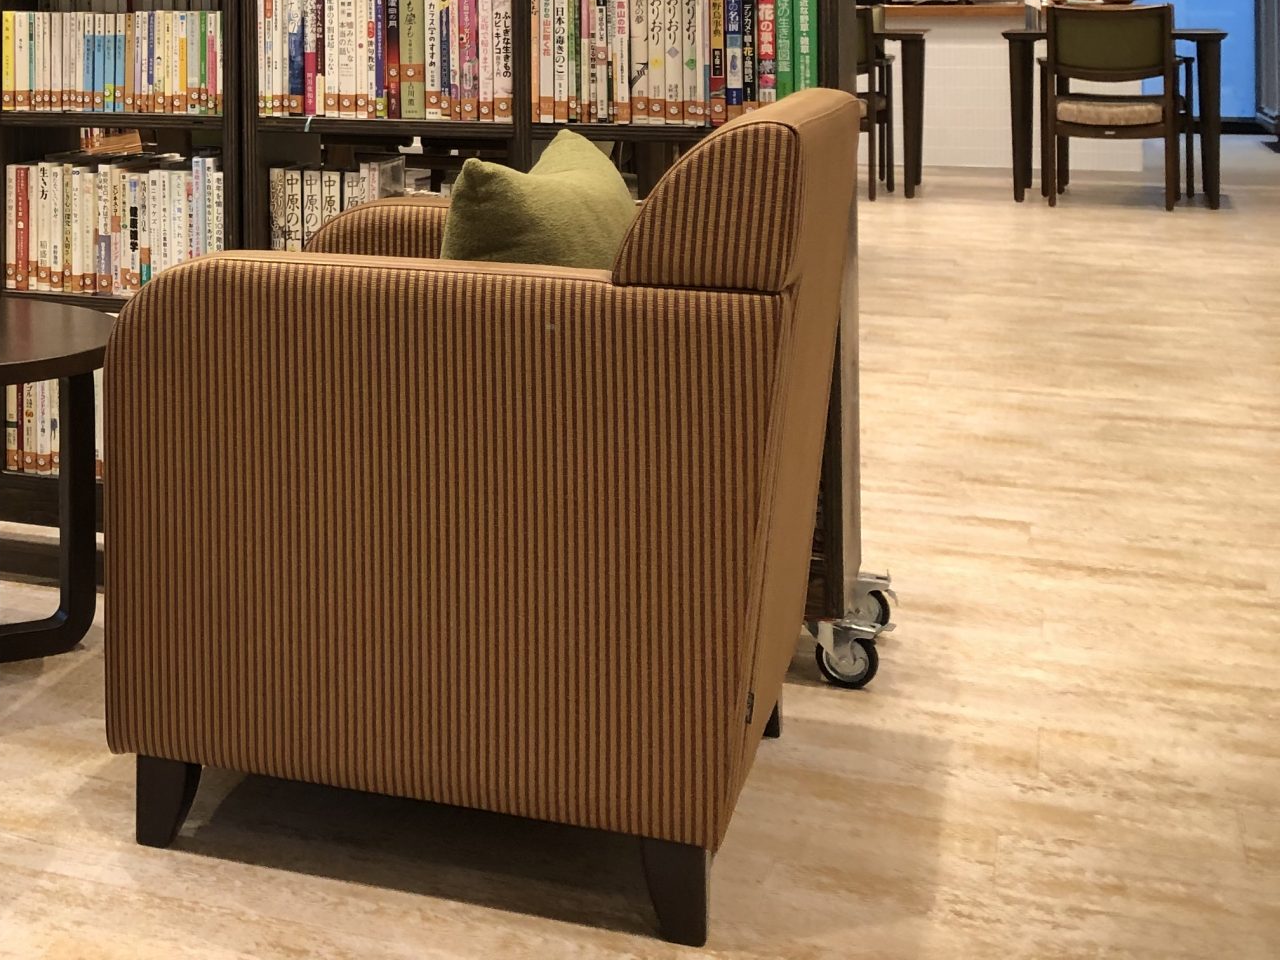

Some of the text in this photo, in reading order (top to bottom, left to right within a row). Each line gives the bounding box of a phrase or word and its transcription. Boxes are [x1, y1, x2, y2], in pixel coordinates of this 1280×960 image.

[428, 1, 436, 68] カラス学のすすめ
[555, 7, 565, 74] 日本の毒きのこ
[616, 1, 626, 35] 高山の花
[758, 3, 773, 55] 花の事典
[502, 12, 511, 78] ふしぎな生きもの
[39, 166, 49, 200] 生き方
[286, 174, 300, 241] 中原の虹
[324, 176, 337, 223] 中原の
[39, 240, 48, 267] 稲盛和
